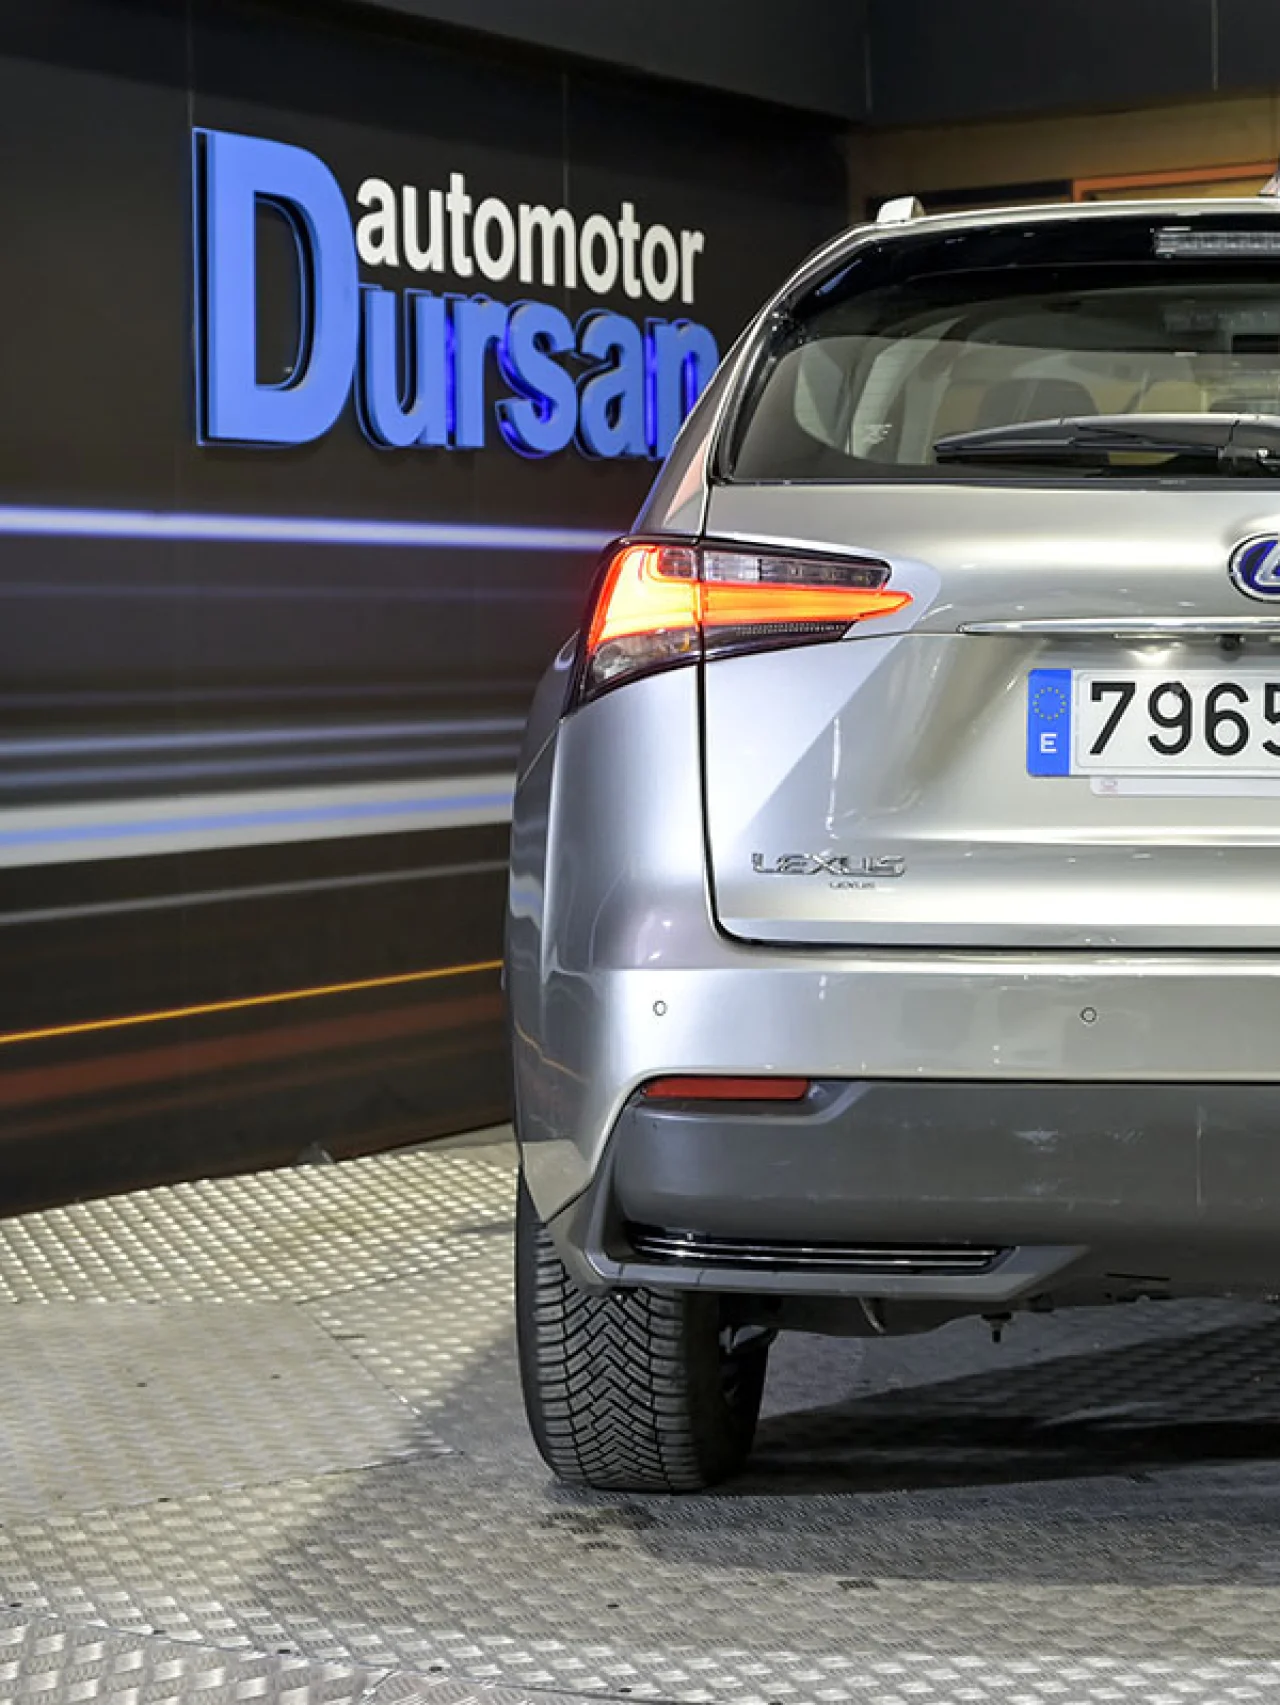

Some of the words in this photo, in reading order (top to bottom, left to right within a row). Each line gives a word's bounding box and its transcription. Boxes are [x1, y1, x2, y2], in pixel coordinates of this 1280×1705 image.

[356, 172, 705, 304] automotor
[191, 126, 719, 460] Dursan
[1040, 733, 1057, 753] E
[752, 852, 908, 878] LEXUS
